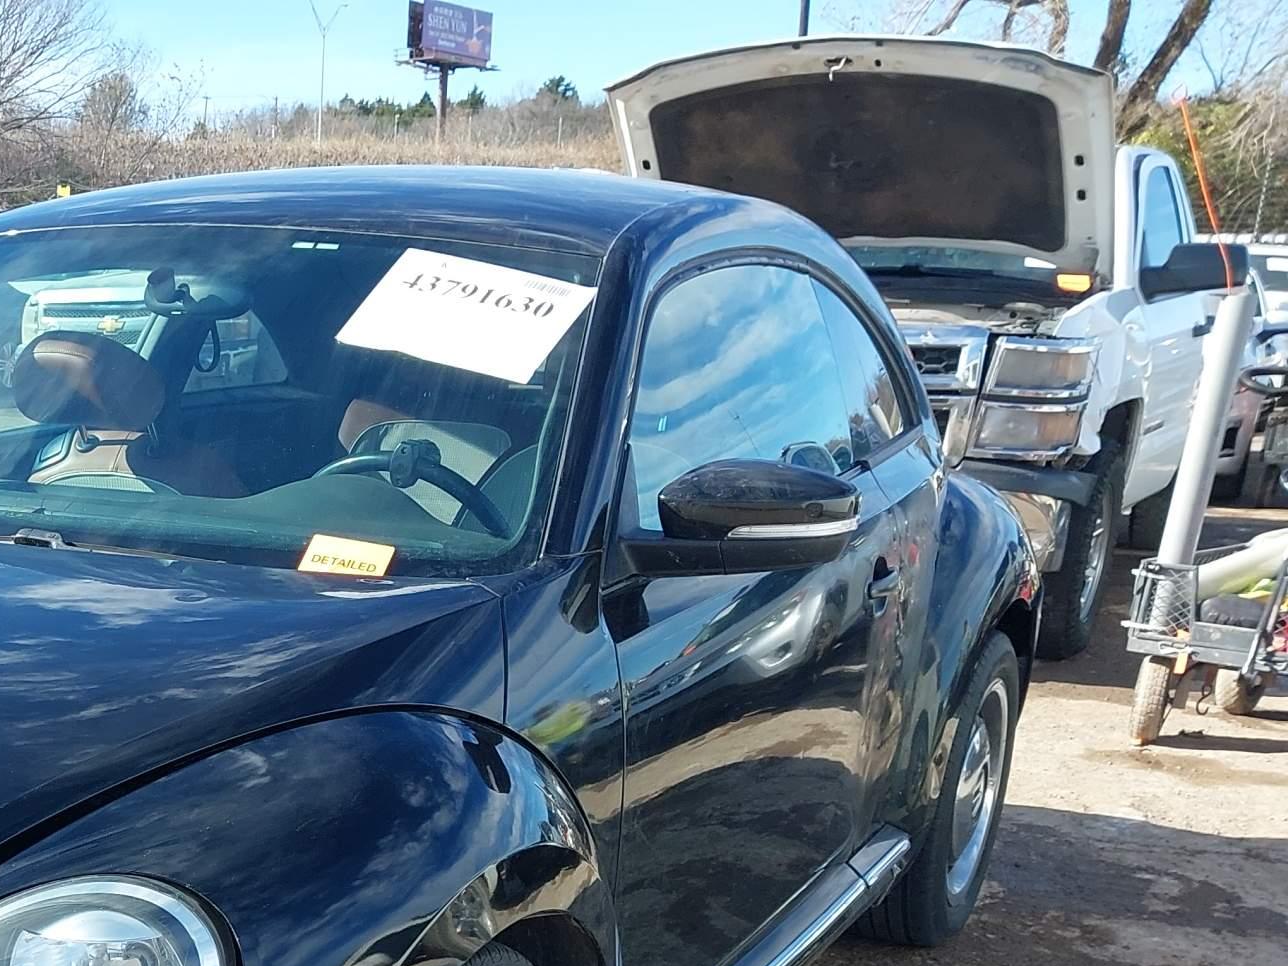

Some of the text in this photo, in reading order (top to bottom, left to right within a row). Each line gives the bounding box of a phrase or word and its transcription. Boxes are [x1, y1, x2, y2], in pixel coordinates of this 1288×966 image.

[427, 13, 468, 33] SHEN YUN
[402, 272, 556, 319] 43791630
[311, 554, 378, 573] DETAILED
